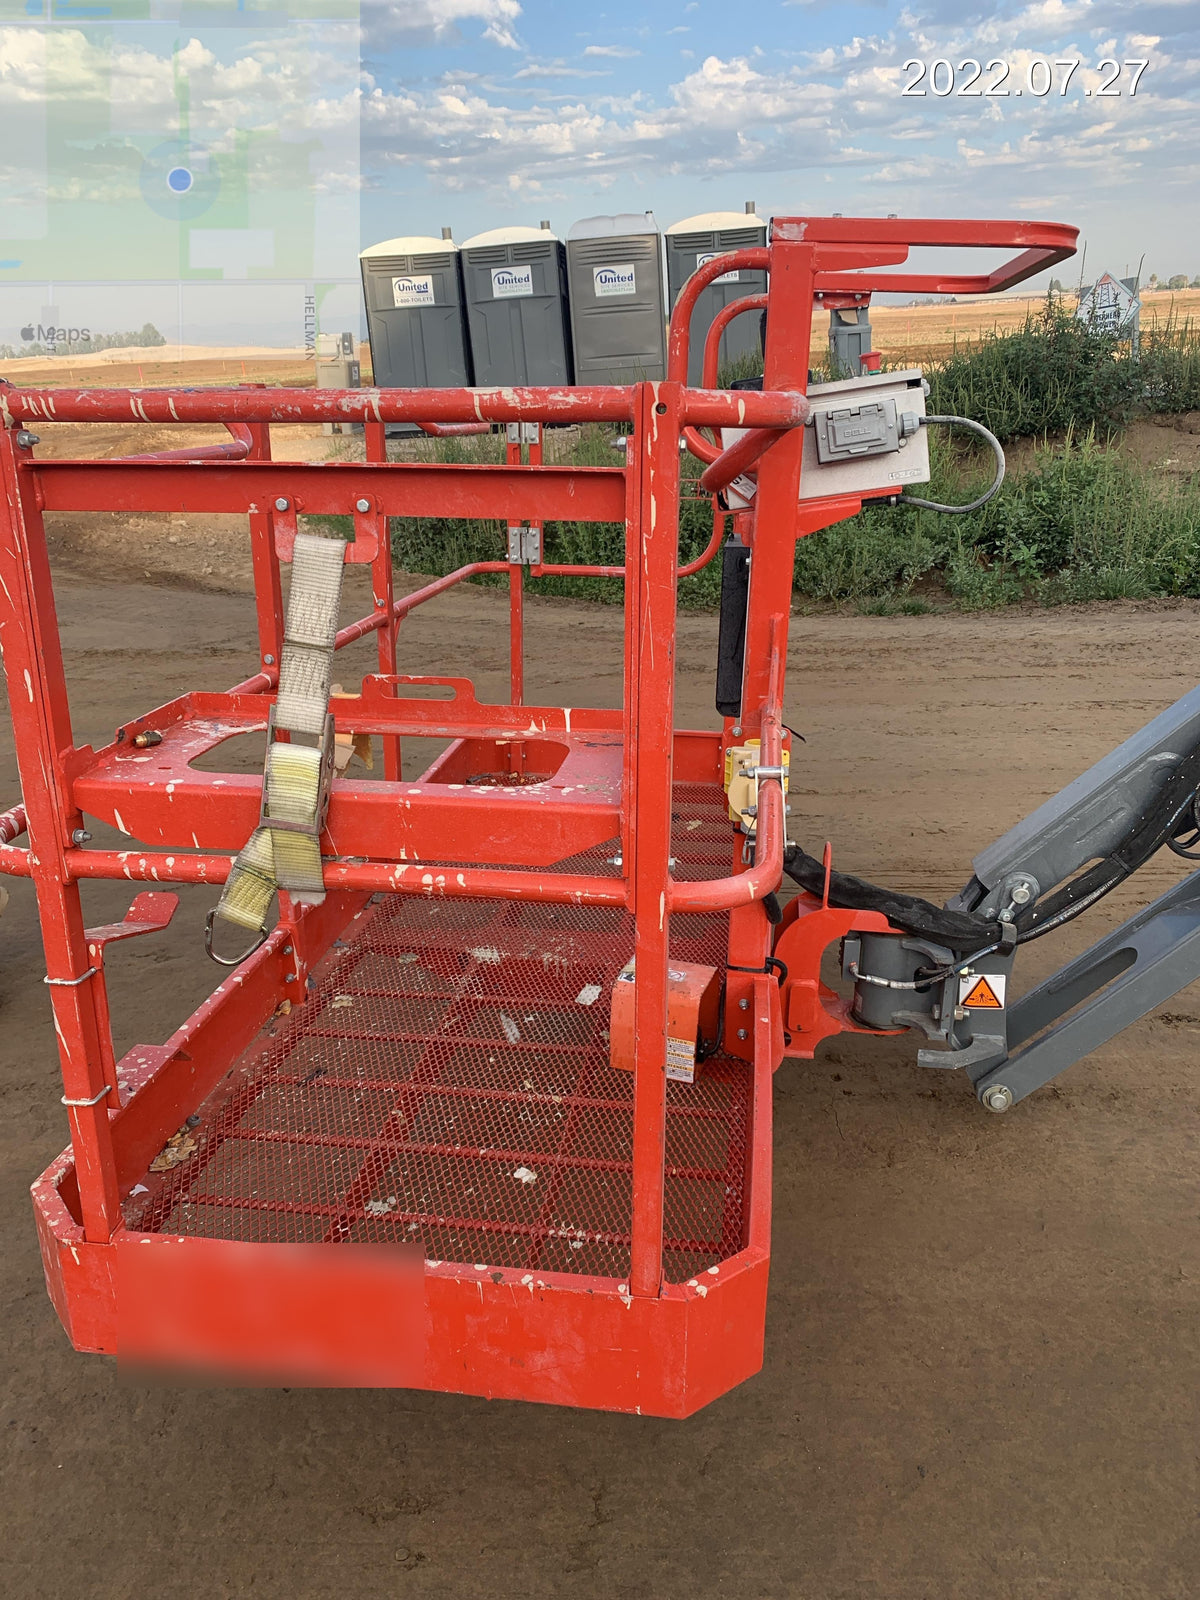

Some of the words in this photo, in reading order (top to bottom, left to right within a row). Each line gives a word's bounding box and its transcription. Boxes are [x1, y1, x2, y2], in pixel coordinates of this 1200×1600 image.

[497, 273, 530, 285] United
[600, 273, 634, 284] United
[398, 281, 428, 291] United
